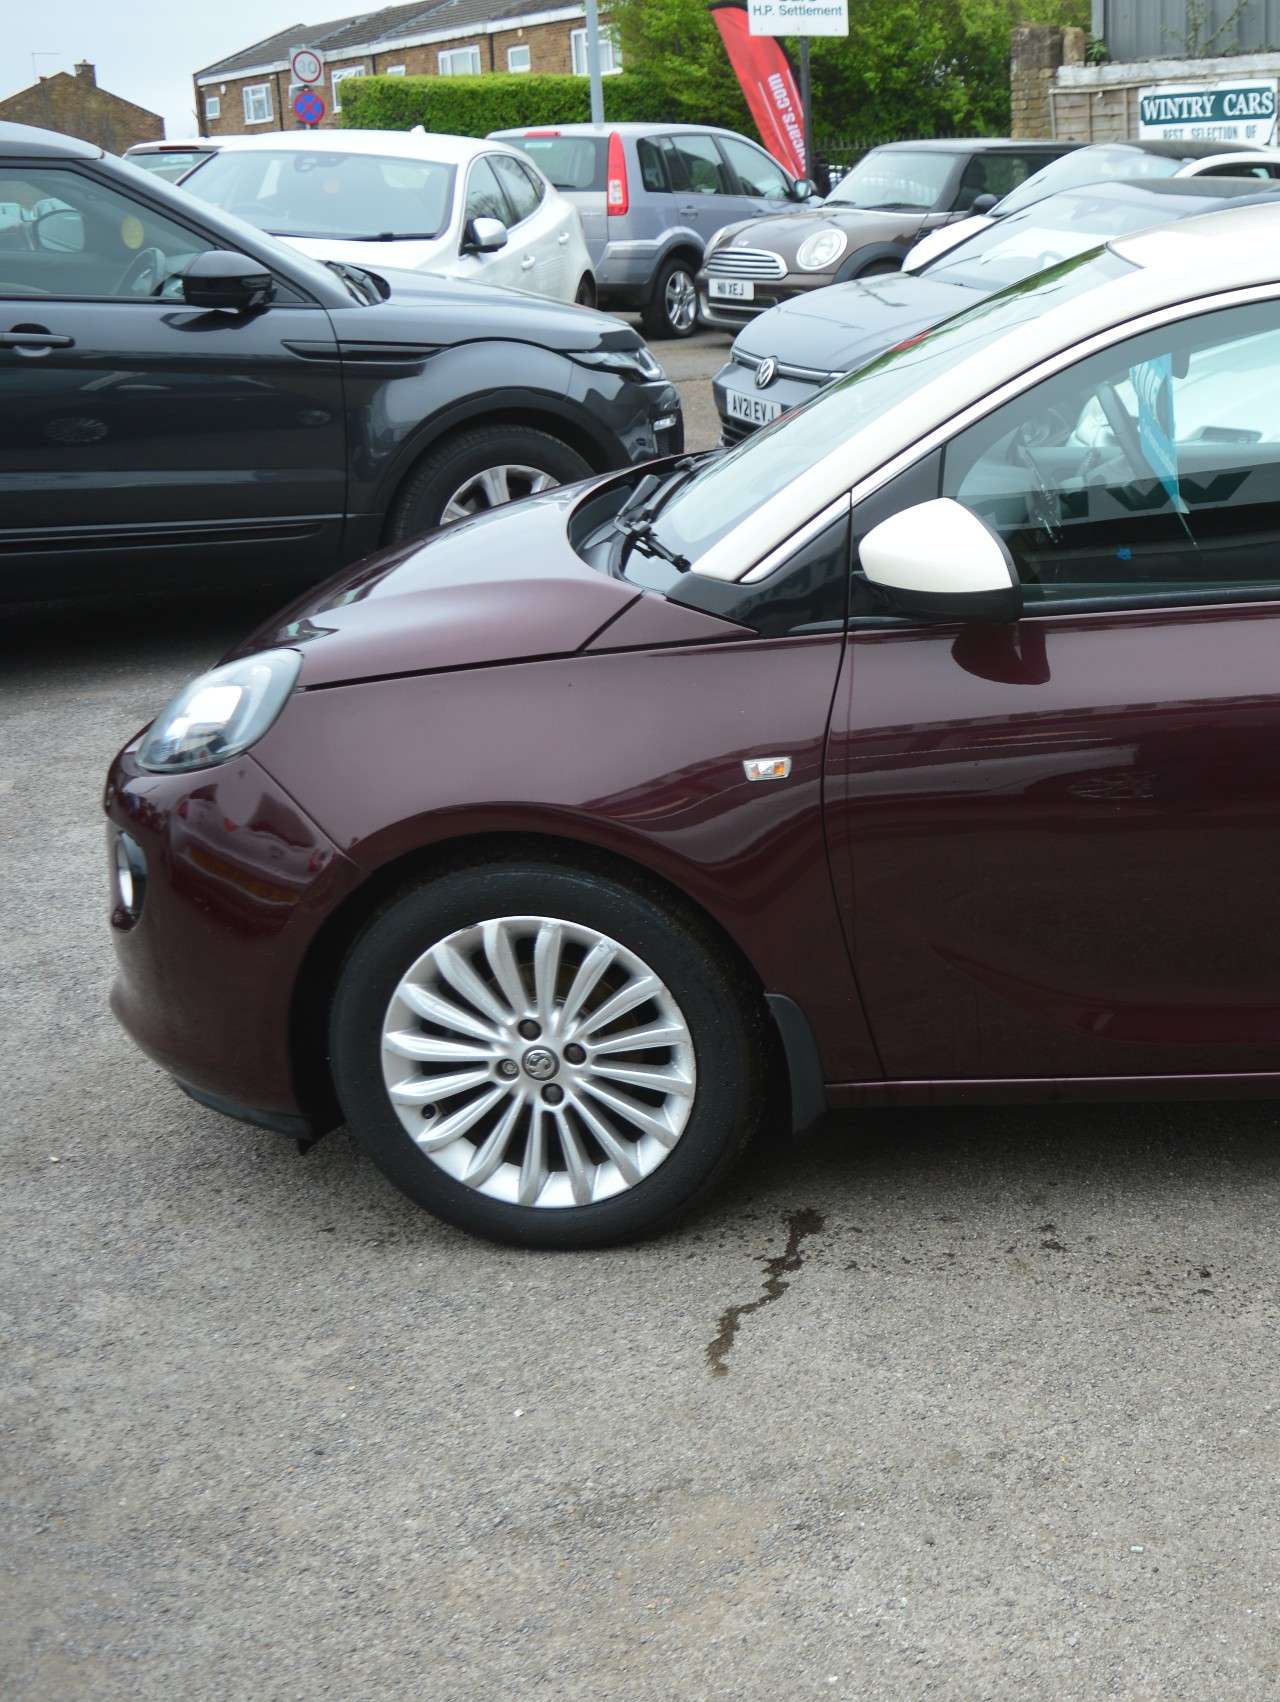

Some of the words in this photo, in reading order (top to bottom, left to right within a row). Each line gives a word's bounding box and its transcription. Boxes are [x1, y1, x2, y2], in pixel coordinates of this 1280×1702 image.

[753, 5, 775, 16] H.P.
[779, 5, 842, 16] Settlement
[1142, 94, 1216, 121] WINTRY
[1222, 91, 1274, 116] CARS
[1191, 126, 1238, 139] SELECTION
[1245, 125, 1257, 139] OF
